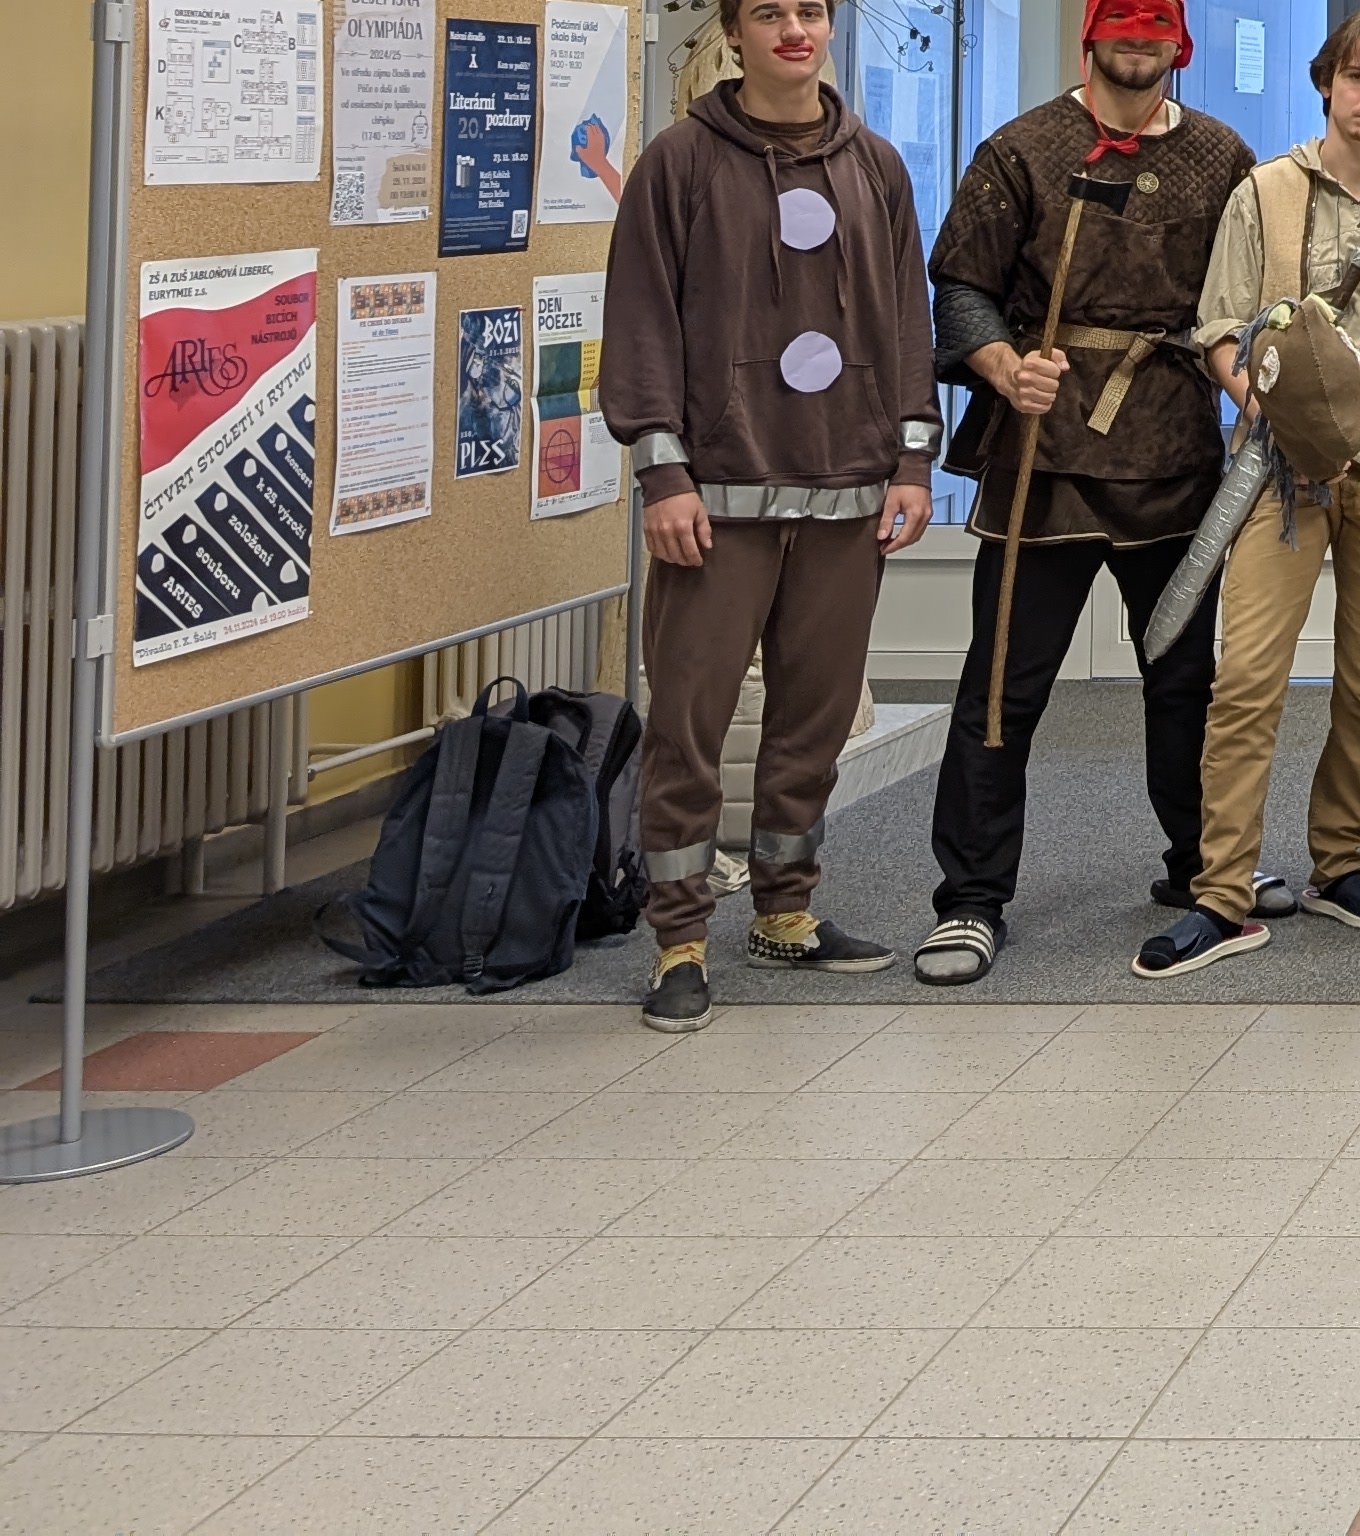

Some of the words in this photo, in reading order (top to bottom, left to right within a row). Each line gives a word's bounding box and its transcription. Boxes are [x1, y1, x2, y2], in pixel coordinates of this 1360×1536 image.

[214, 9, 231, 20] PLÁN
[274, 11, 284, 24] A
[347, 16, 423, 40] OLYMPIÁDA
[551, 19, 582, 31] Podzimní
[582, 21, 599, 32] úklid
[234, 34, 243, 48] C
[288, 38, 296, 50] B
[551, 31, 570, 42] okolo
[570, 32, 587, 46] školy
[369, 49, 402, 60] 2024/25
[157, 59, 167, 73] D
[392, 69, 410, 78] člověk
[449, 92, 496, 111] Literární
[155, 106, 165, 120] K
[485, 108, 532, 131] pozdravy
[457, 117, 484, 139] 20.
[149, 270, 160, 284] ZŠ
[161, 273, 169, 283] A
[170, 269, 188, 283] ZUŠ
[189, 265, 238, 282] JABLOŇOVÁ
[239, 265, 274, 276] LIBEREC,
[149, 287, 193, 301] EURYTMIE
[274, 293, 309, 306] SOUBOR
[538, 297, 562, 314] DEN
[266, 309, 298, 325] BICÍCH
[538, 312, 583, 331] POEZIE
[251, 327, 297, 345] NÁSTROJŮ
[482, 311, 519, 349] BOŽÍ
[144, 467, 195, 520] ČTVRT
[197, 406, 258, 474] STOLETÍ
[254, 399, 265, 417] V
[266, 353, 313, 408] RYTMU
[284, 450, 313, 489] koncert
[255, 477, 265, 493] k
[263, 487, 278, 508] 25.
[278, 504, 308, 540] výročí
[227, 514, 275, 567] založení
[195, 546, 242, 600] souboru
[163, 575, 204, 619] ARIES
[223, 619, 259, 635] 24.11.2024
[259, 616, 269, 625] od
[287, 606, 307, 619] hodin
[194, 629, 217, 644] Šaldy
